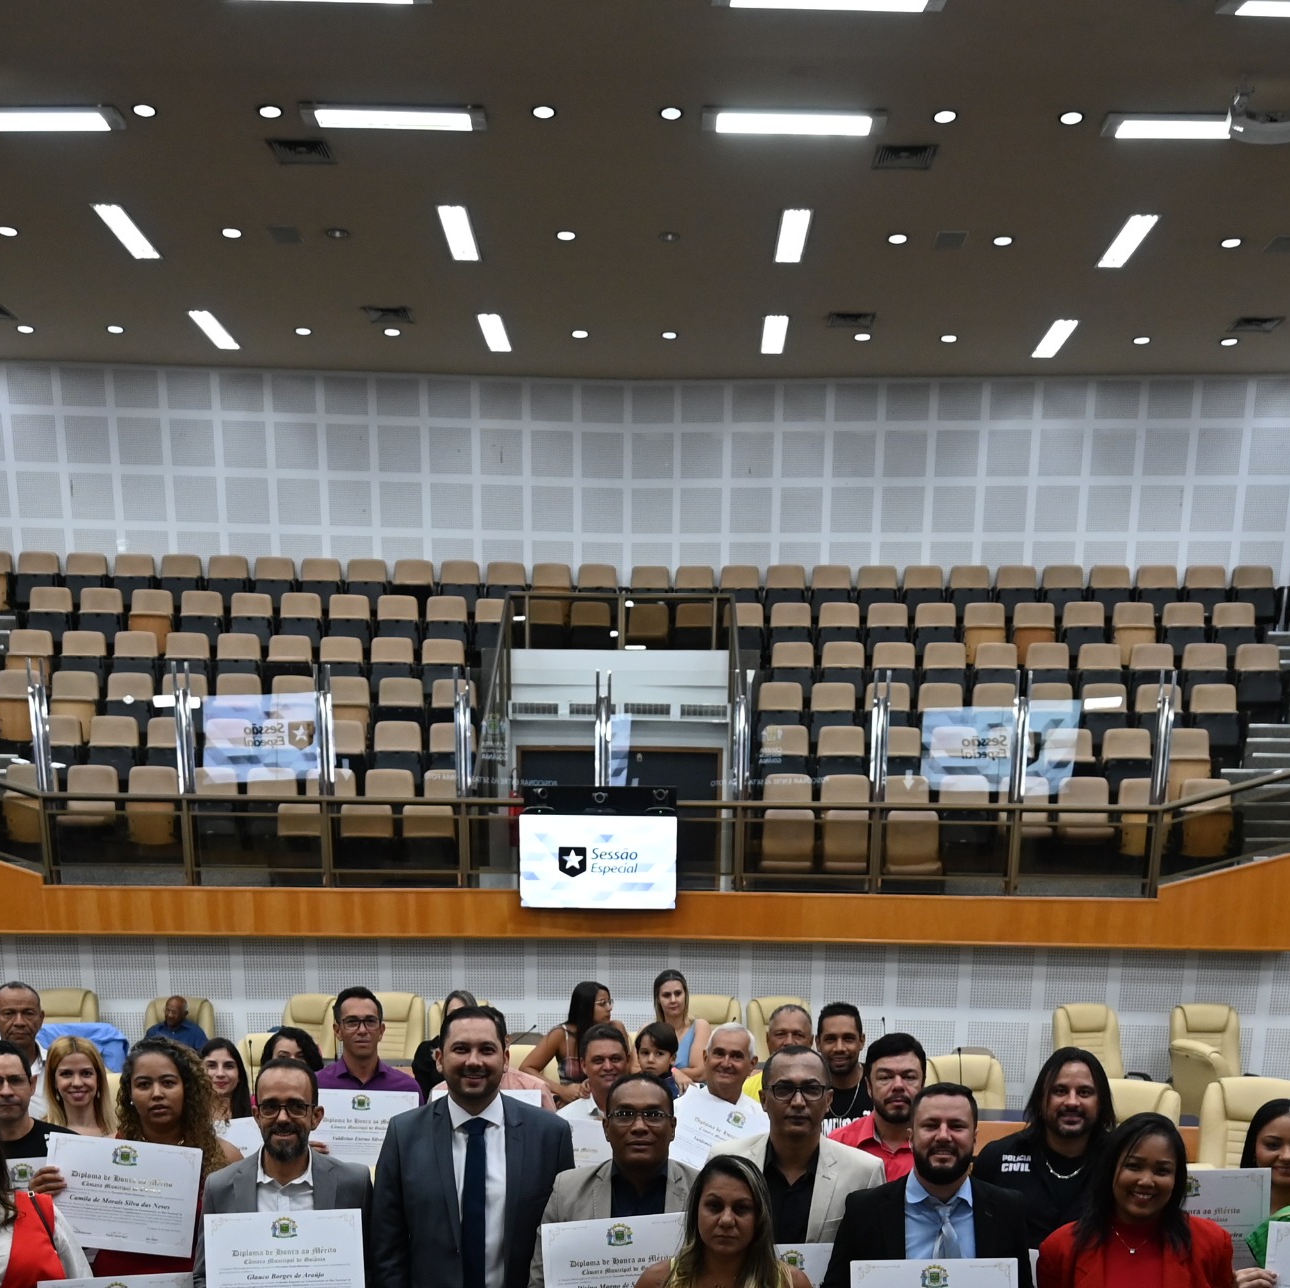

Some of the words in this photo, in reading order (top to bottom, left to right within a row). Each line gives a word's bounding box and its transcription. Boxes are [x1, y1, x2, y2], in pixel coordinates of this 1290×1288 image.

[591, 848, 638, 861] Sessão
[591, 862, 638, 876] Especial
[1001, 1162, 1031, 1172] CIVIL
